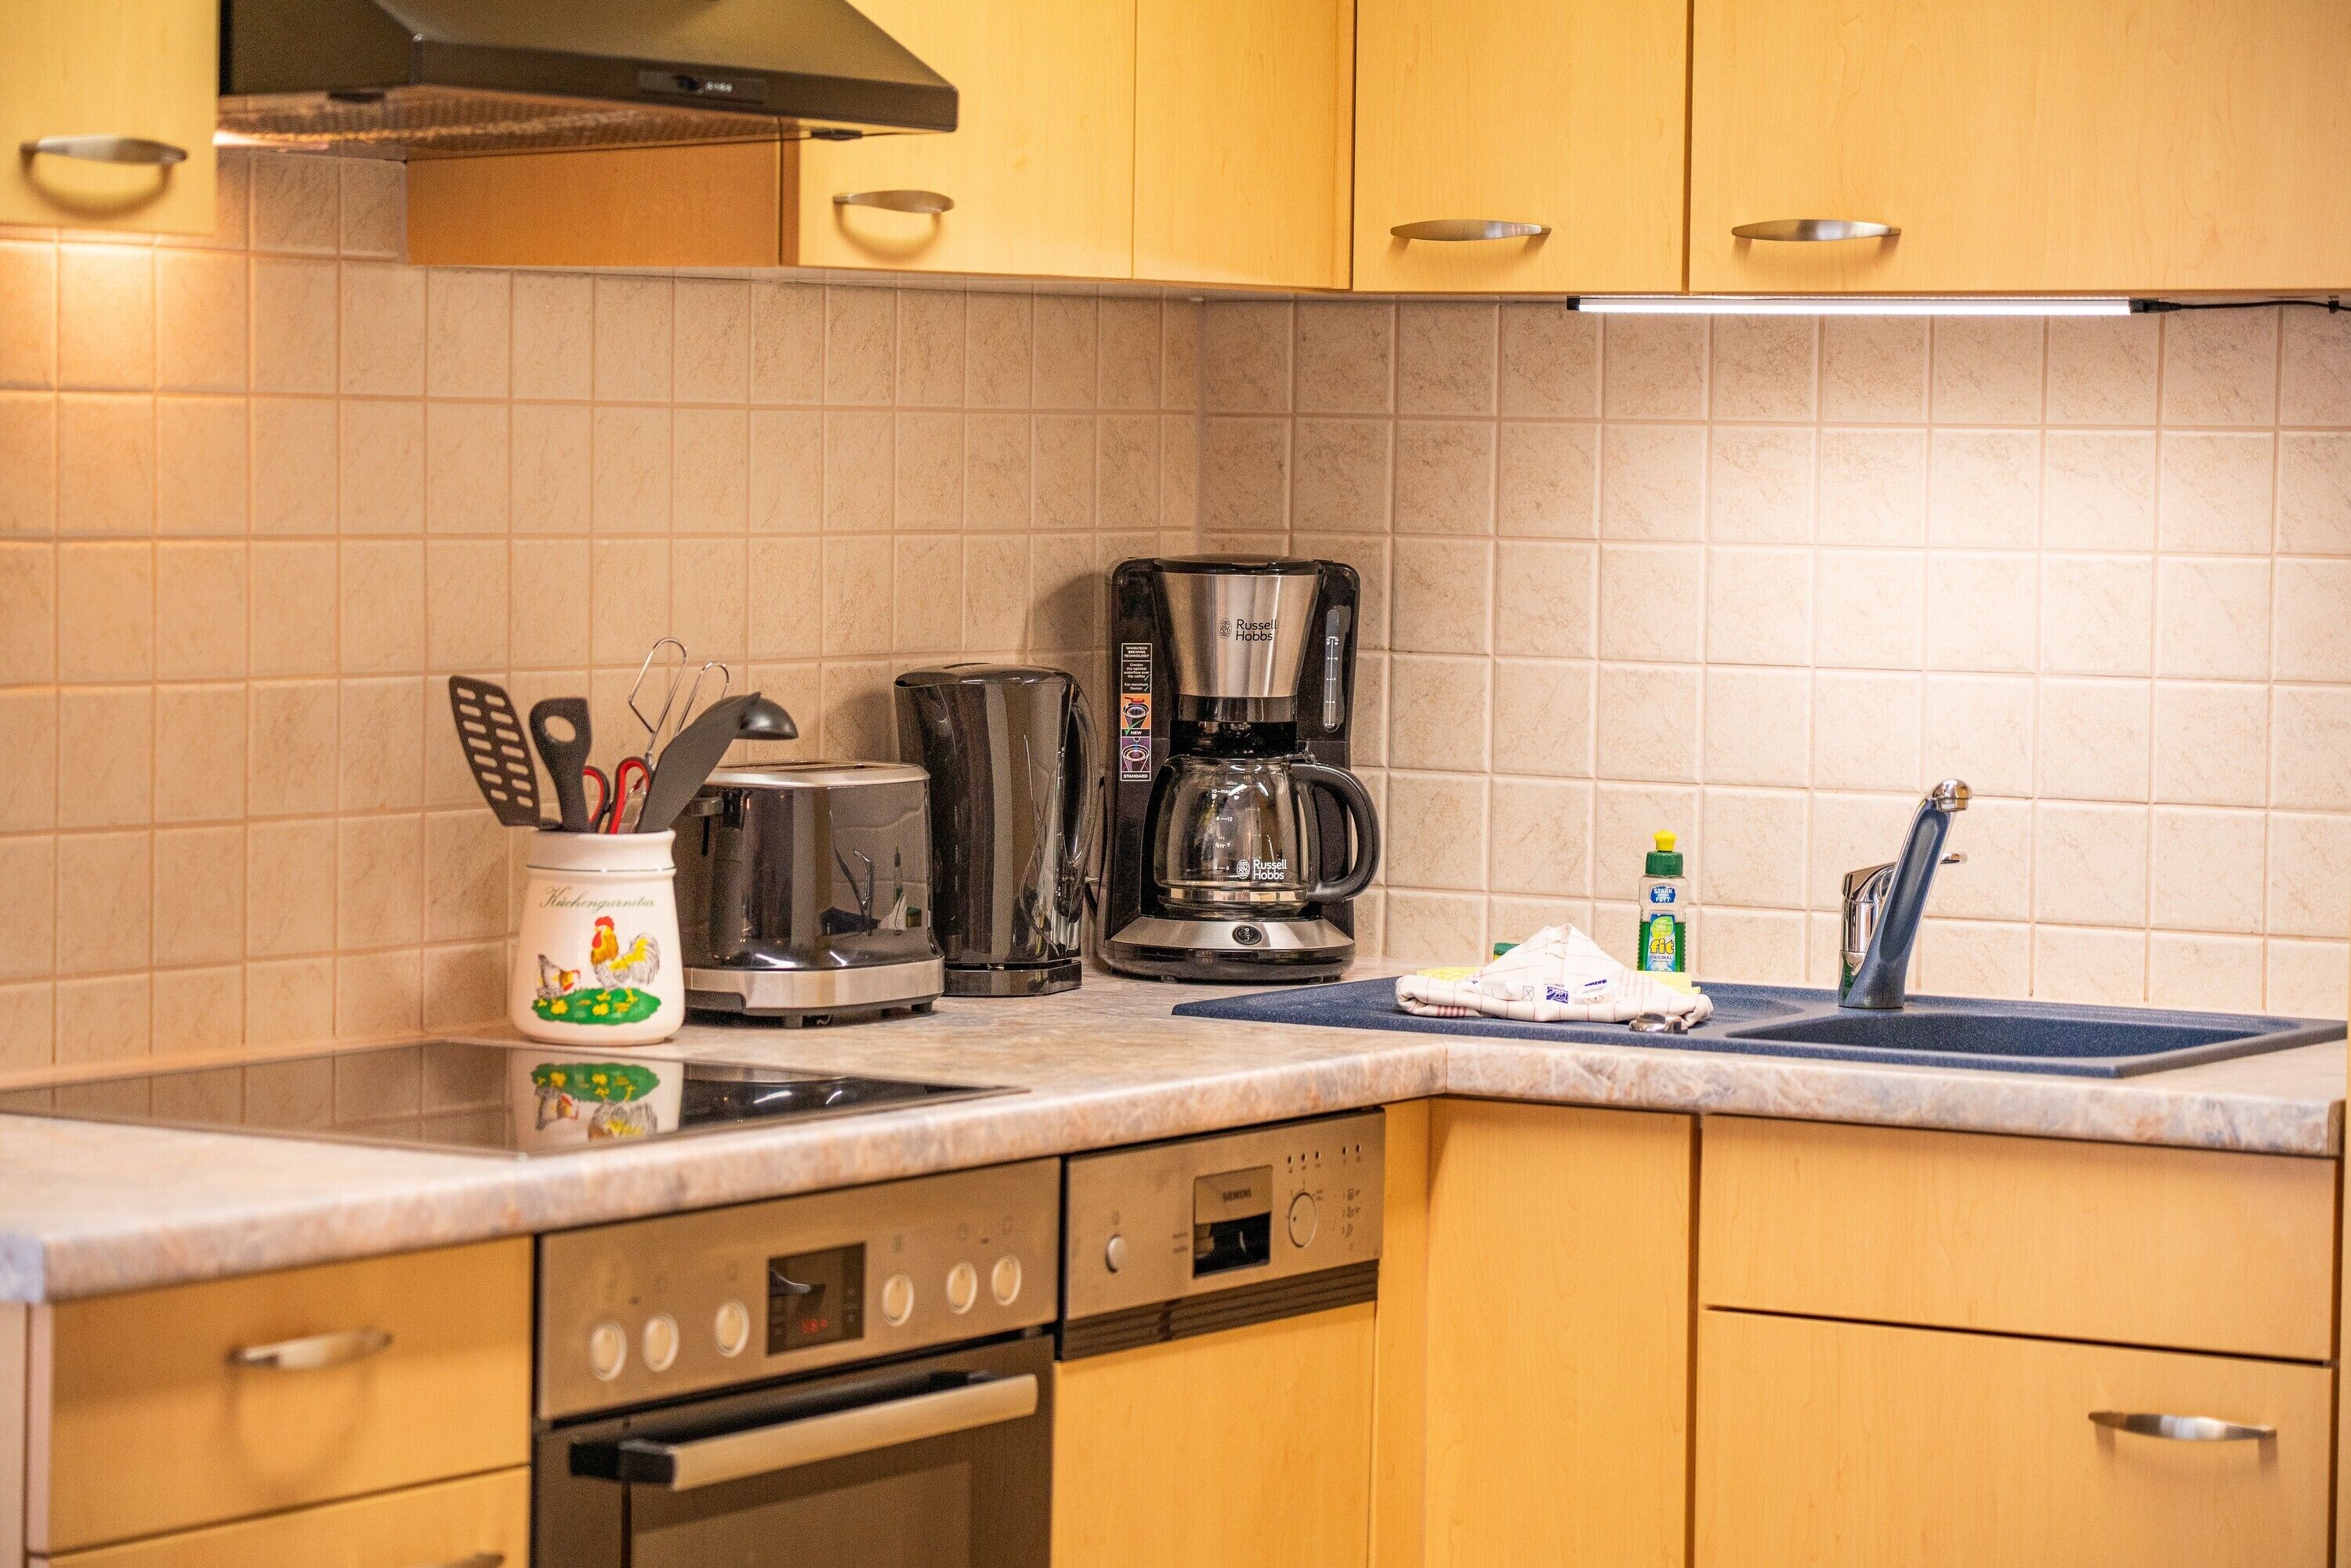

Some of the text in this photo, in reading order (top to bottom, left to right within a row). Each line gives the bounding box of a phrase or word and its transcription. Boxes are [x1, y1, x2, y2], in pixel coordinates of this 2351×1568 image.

[1236, 618, 1277, 630] Russell
[1235, 630, 1273, 641] Hobbs
[1253, 859, 1288, 871] Russell
[1252, 869, 1285, 880] Hobbs
[1650, 938, 1674, 954] fit
